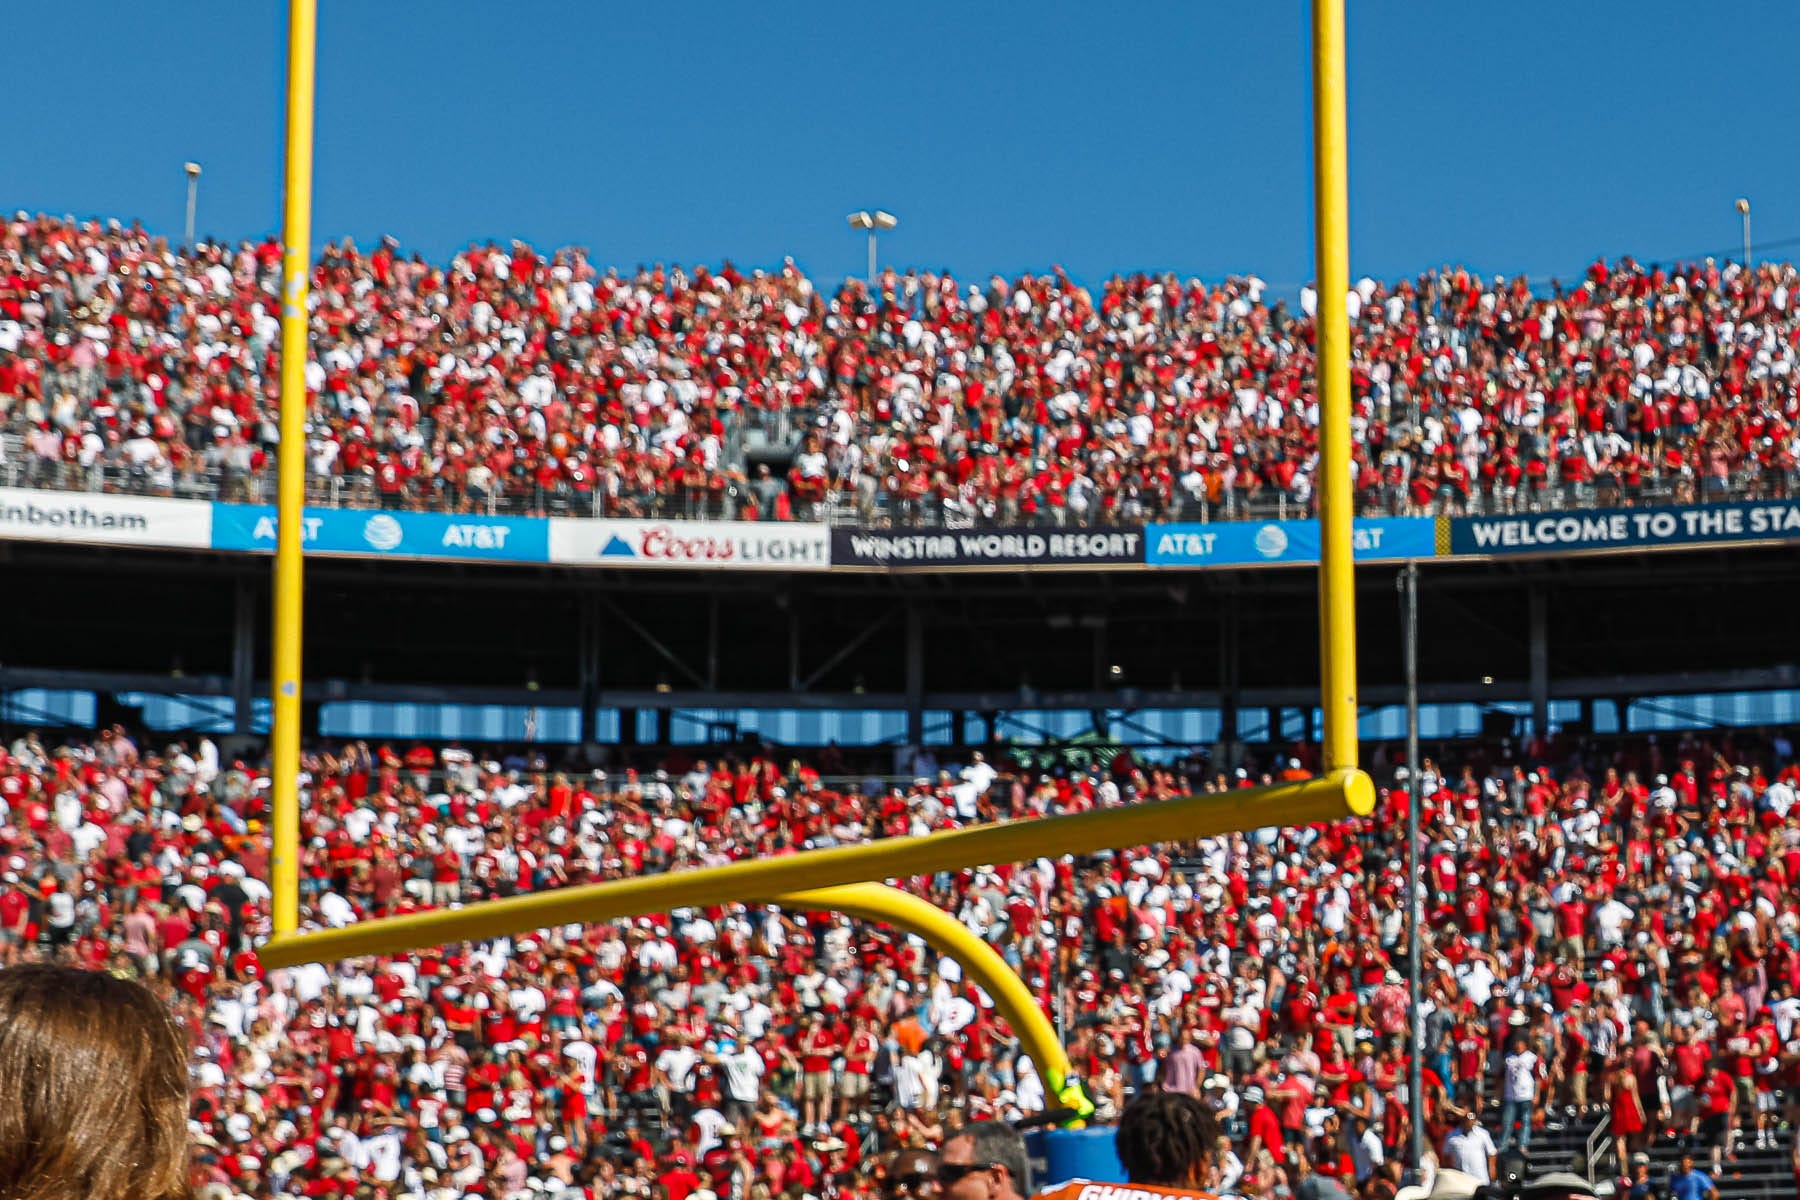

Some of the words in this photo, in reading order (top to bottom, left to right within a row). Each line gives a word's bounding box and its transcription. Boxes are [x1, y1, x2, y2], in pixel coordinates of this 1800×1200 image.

[443, 525, 509, 549] AT&T
[1472, 515, 1628, 547] WELCOME
[1633, 511, 1677, 540] TO
[1681, 503, 1744, 536] THE
[638, 526, 734, 561] Coors
[739, 538, 825, 562] LIGHT
[851, 534, 957, 561] WINSTAR
[960, 534, 1046, 560] WORLD
[1049, 531, 1139, 558] RESORT
[1157, 532, 1216, 557] AT&T
